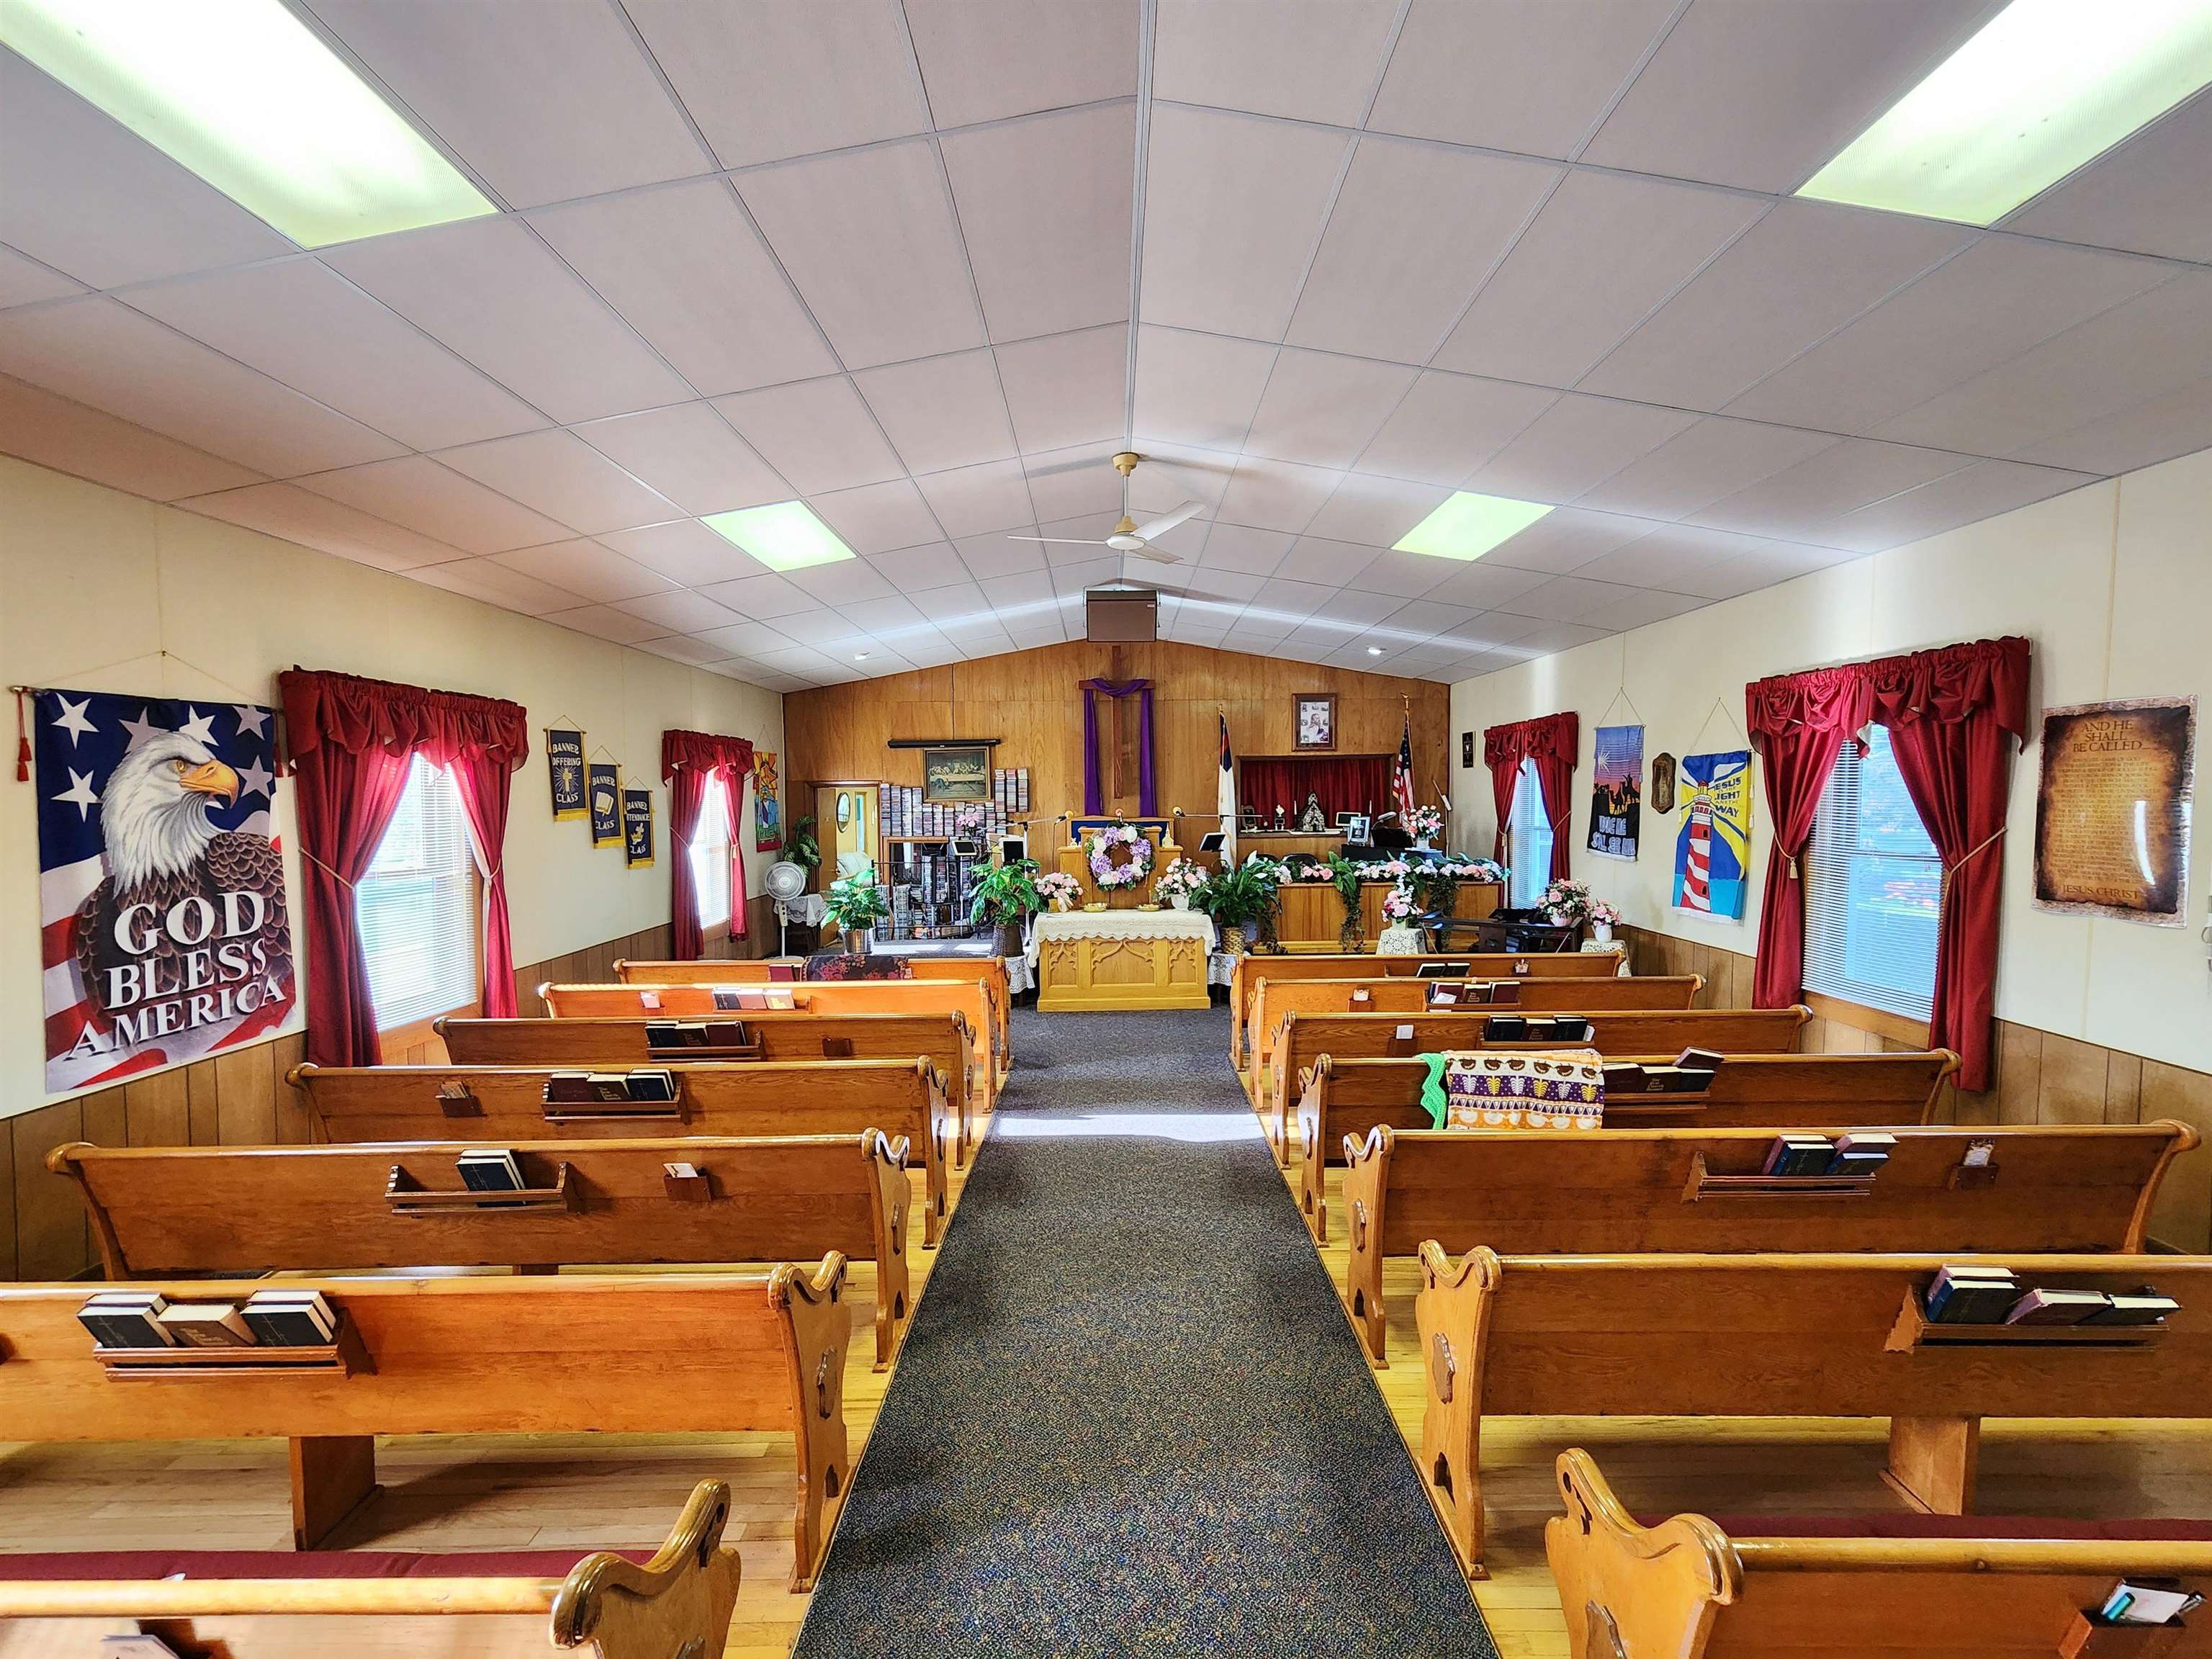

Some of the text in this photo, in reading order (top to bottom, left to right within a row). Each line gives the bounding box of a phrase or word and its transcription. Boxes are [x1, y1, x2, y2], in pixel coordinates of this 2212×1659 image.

[2082, 720, 2133, 732] AND HE
[2085, 731, 2127, 742] SHALL
[552, 742, 580, 755] BANNER
[2073, 742, 2087, 752] BE
[552, 757, 581, 766] OFFERING
[592, 775, 616, 786] BANNER
[556, 792, 578, 804] CLASS
[1714, 791, 1740, 800] IGHT
[1715, 805, 1739, 817] WAY
[2062, 884, 2139, 899] JESUS CHRIST
[114, 890, 265, 955] GOD
[103, 938, 267, 1010] BLESS
[63, 978, 287, 1061] AMERICA
